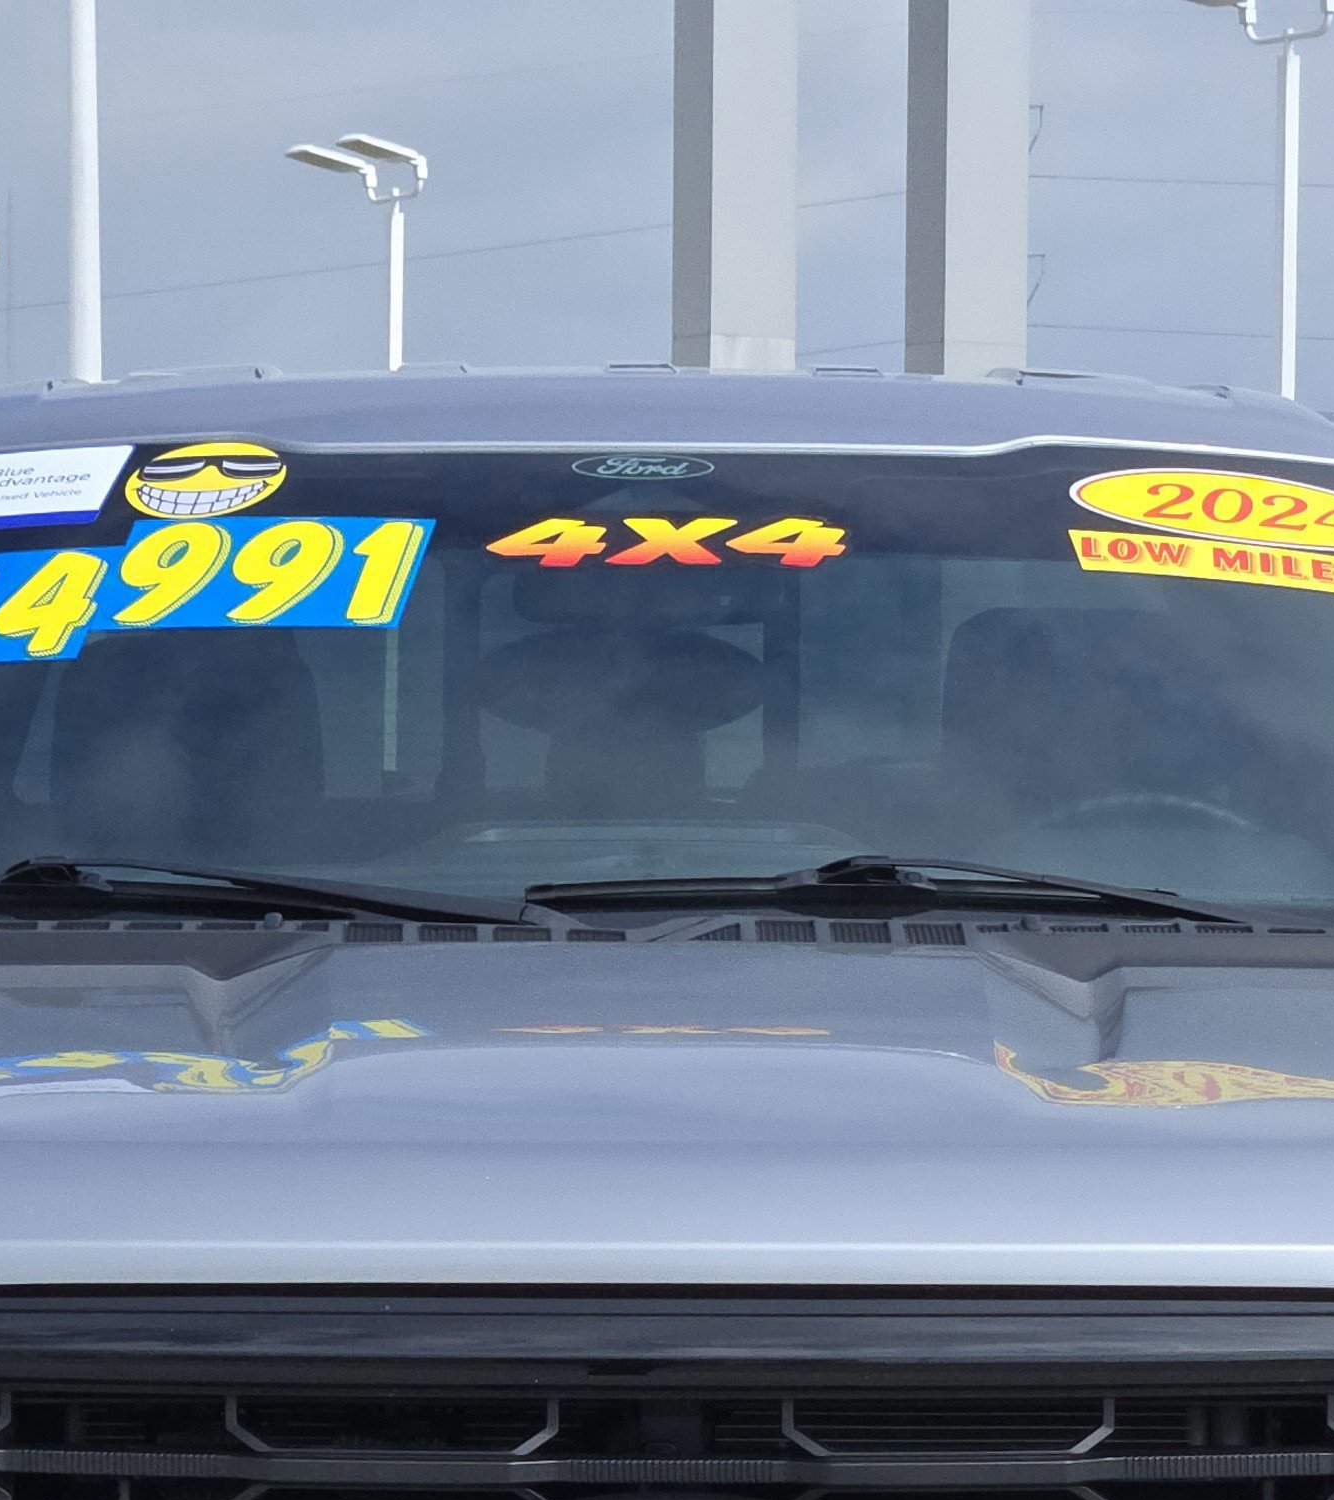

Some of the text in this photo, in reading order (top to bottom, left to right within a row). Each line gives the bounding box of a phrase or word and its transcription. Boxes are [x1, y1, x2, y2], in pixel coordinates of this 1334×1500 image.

[596, 457, 689, 475] Ford
[33, 488, 83, 500] Vehicle
[1081, 536, 1189, 566] LOW
